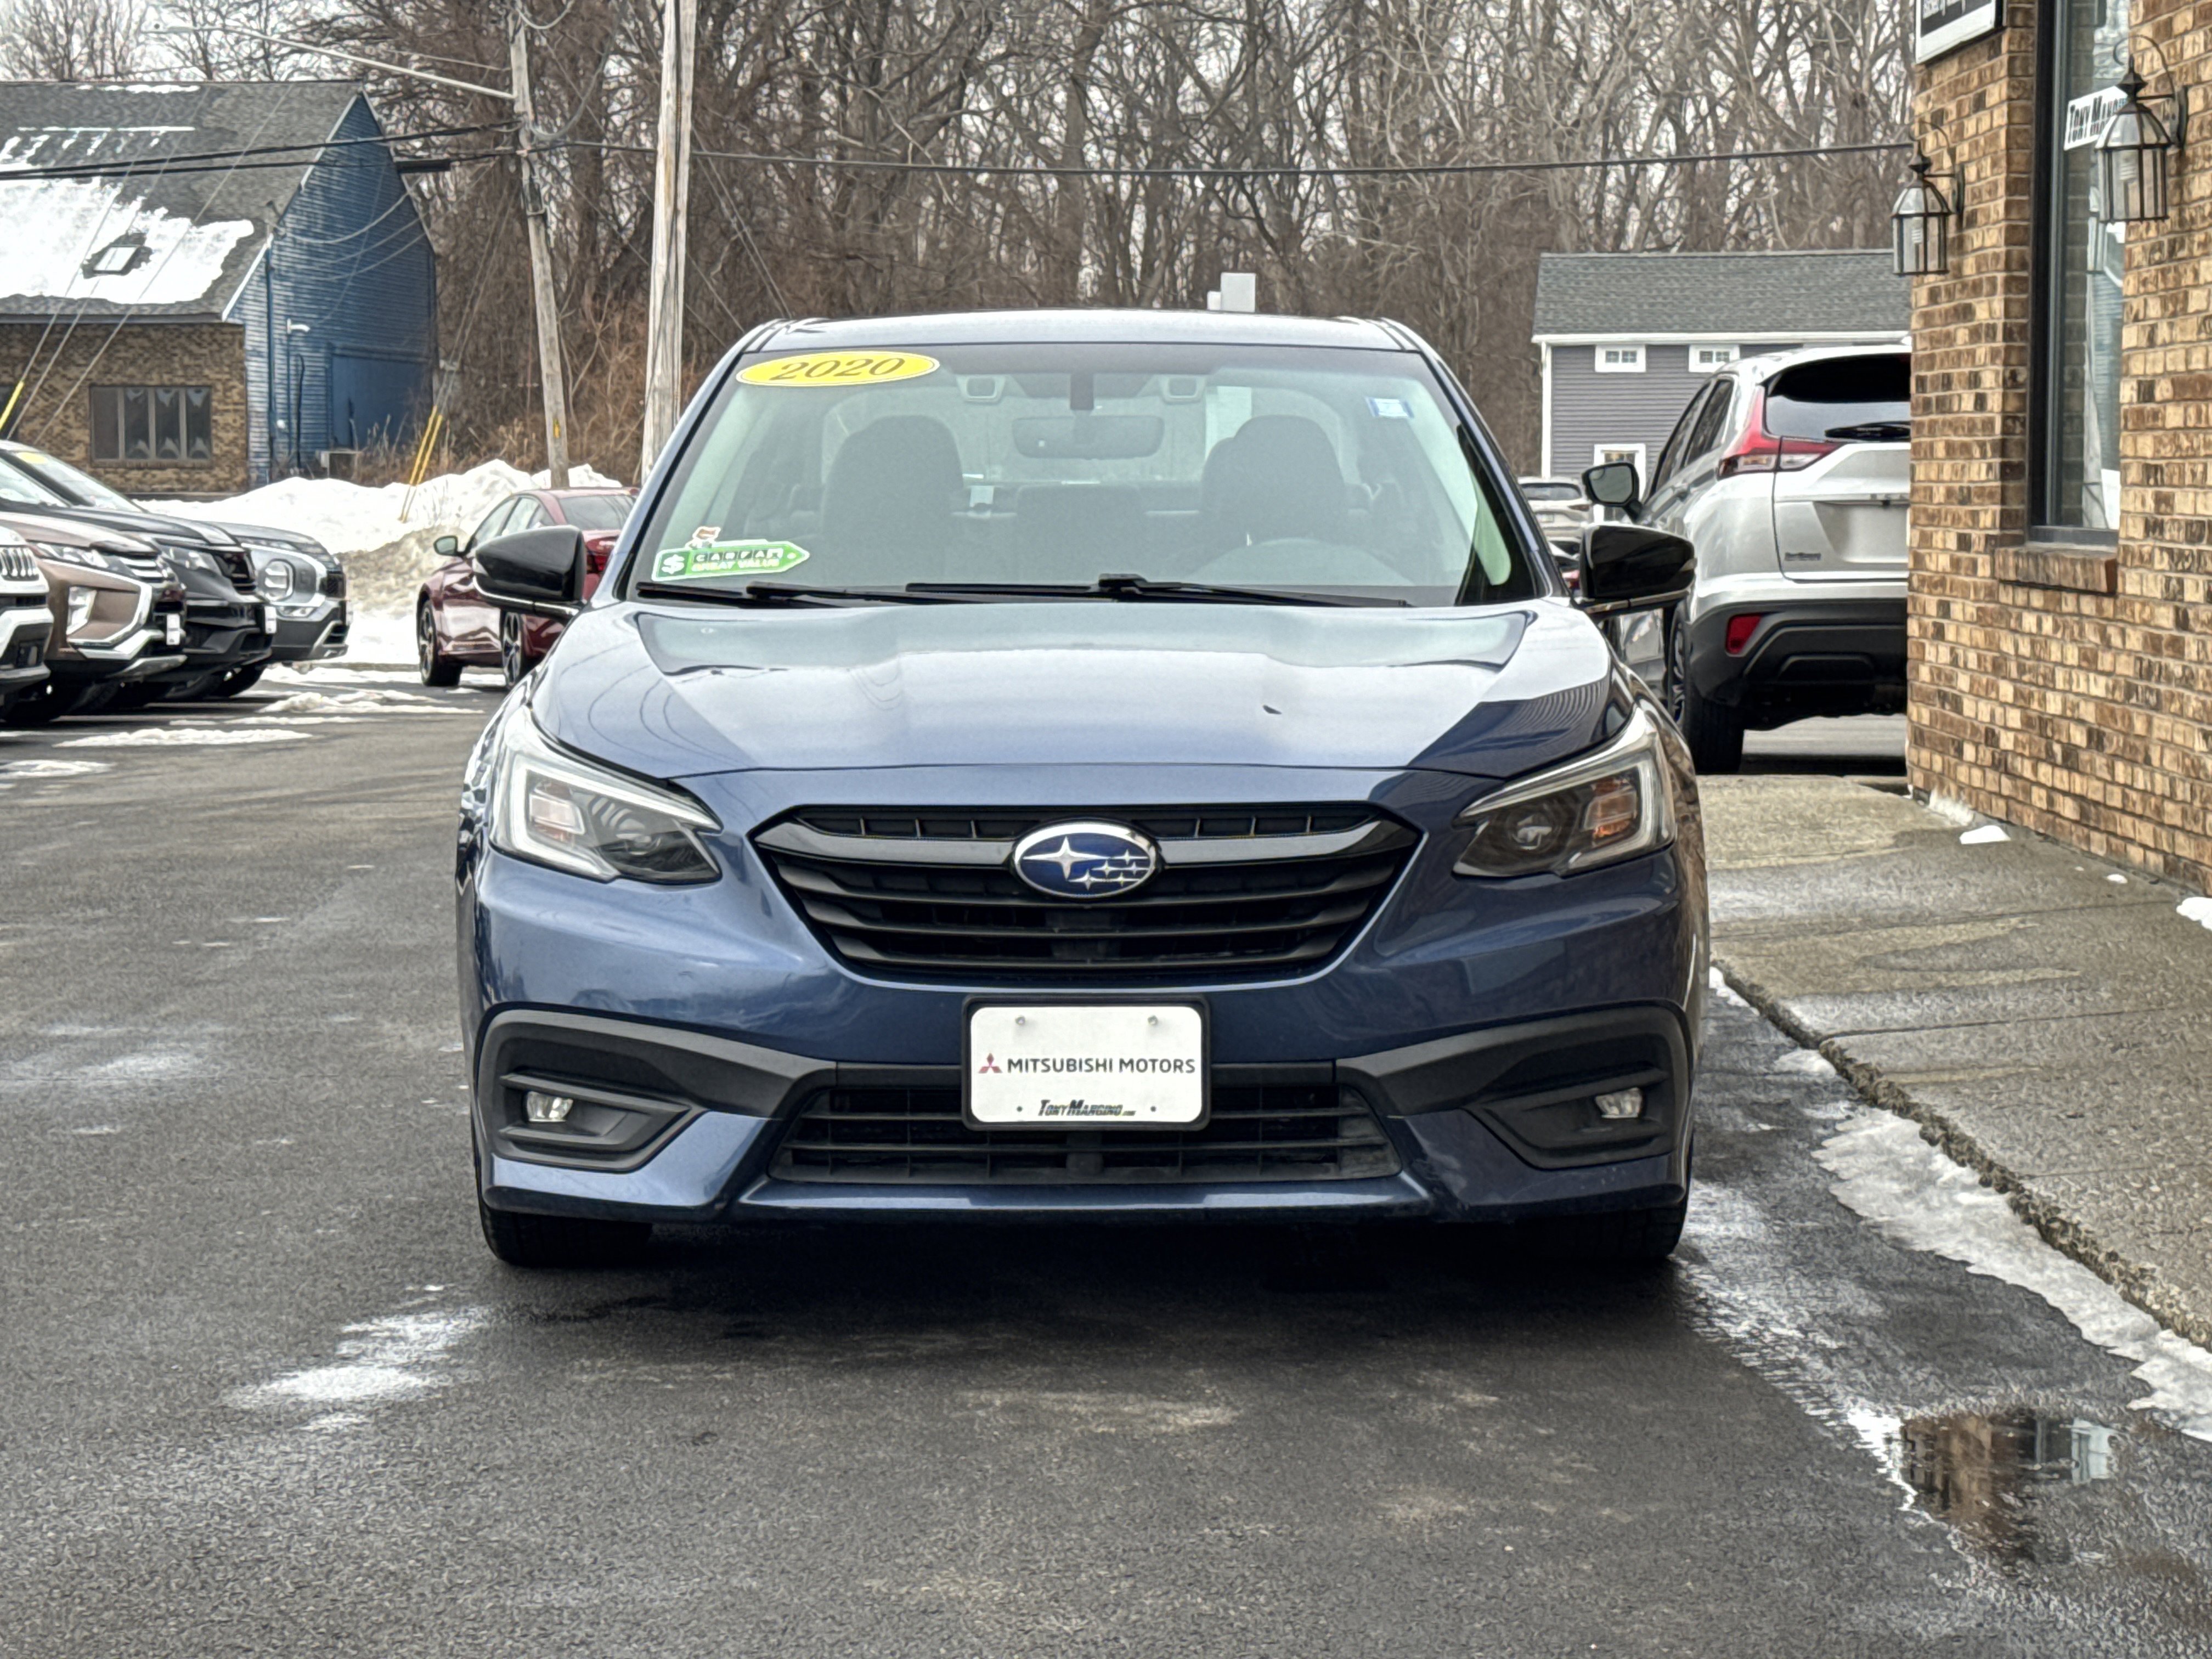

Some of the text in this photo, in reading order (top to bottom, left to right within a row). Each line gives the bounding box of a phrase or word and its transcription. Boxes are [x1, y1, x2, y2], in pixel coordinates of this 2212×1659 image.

[769, 358, 906, 381] 2020
[693, 548, 783, 563] CARFAX
[1007, 1058, 1196, 1074] MITSUBISHI MOTORS
